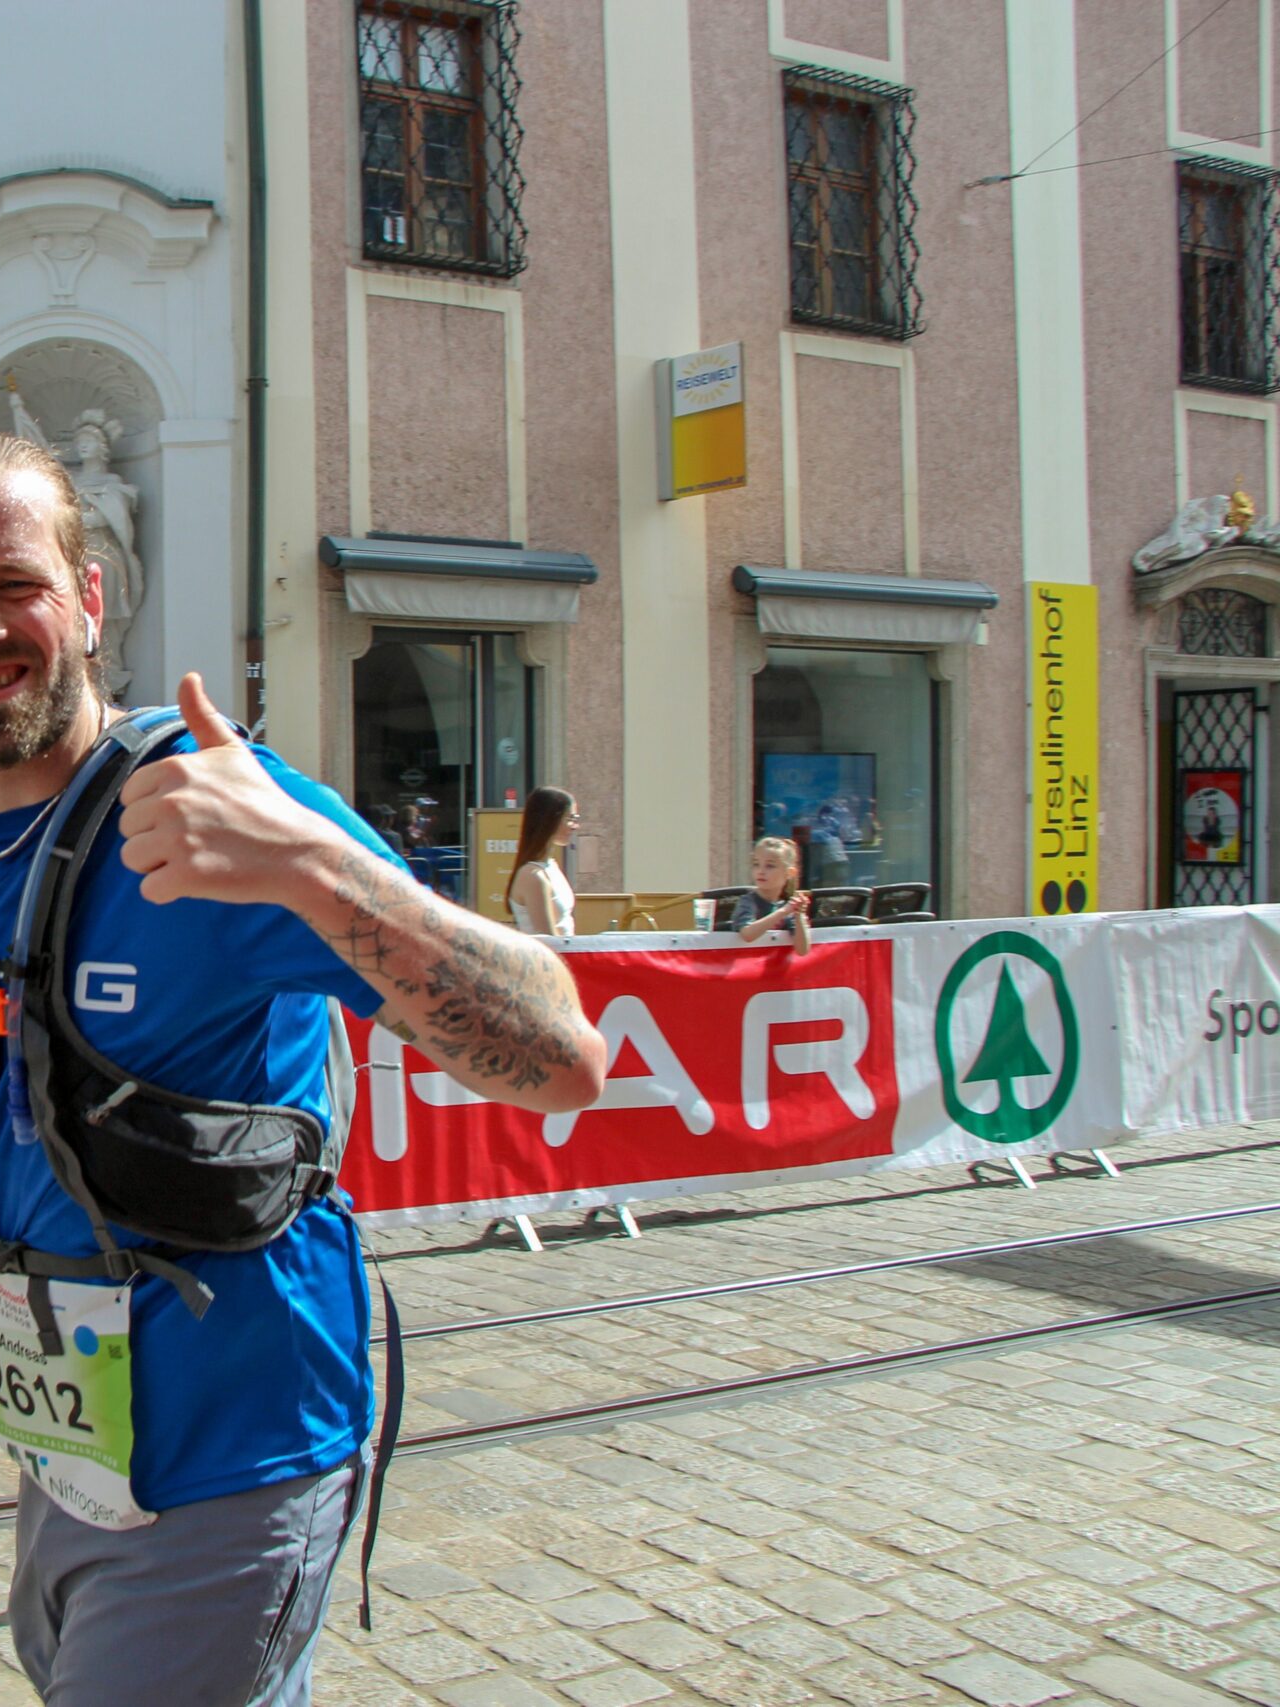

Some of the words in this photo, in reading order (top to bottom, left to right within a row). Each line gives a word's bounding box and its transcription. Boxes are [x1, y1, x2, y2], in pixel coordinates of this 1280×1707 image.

[676, 364, 739, 391] REISEWELT
[1039, 588, 1065, 859] Ursulinenhof
[1065, 774, 1089, 858] Linz
[1203, 989, 1280, 1055] Spo
[0, 1333, 49, 1366] Andreas
[49, 1476, 120, 1522] Nitrogen
